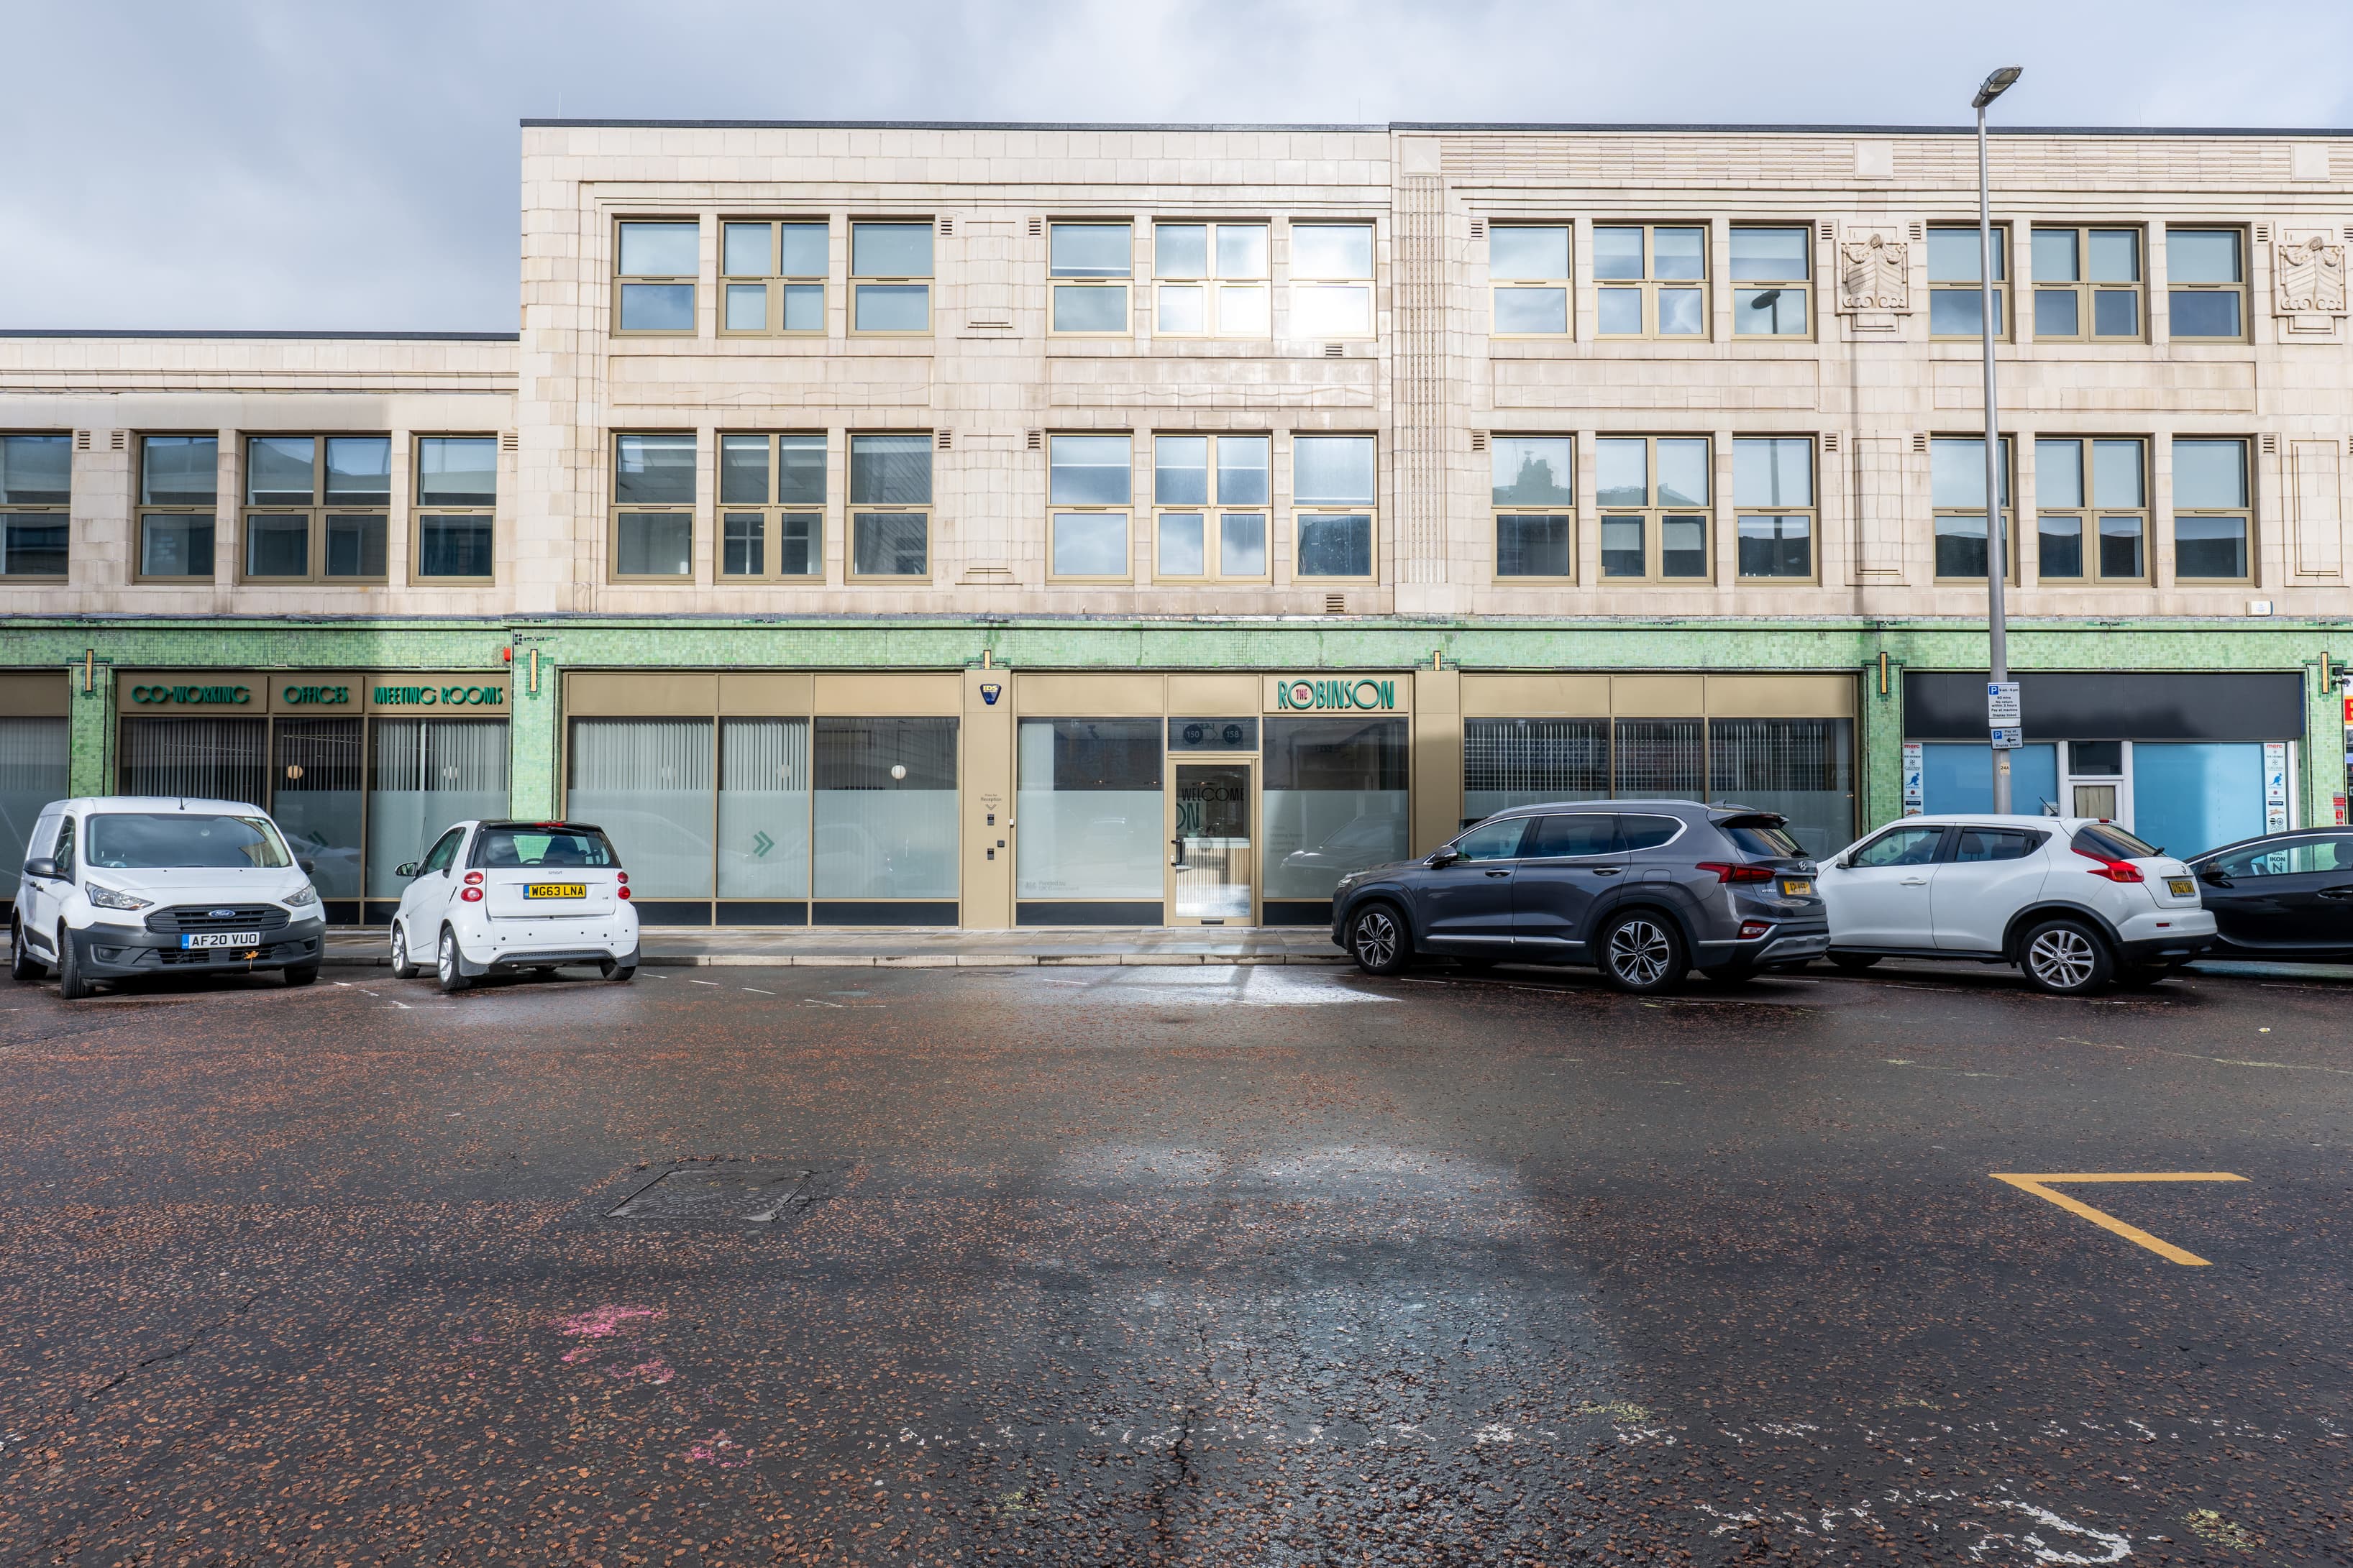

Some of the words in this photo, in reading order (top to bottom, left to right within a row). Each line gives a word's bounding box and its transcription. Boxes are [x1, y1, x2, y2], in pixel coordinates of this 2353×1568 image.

[131, 685, 250, 704] CO-WORKING
[283, 686, 349, 705] OFFICES
[373, 687, 437, 705] MEETING
[440, 686, 503, 705] ROOMS
[1278, 679, 1394, 710] ROBINSON
[1296, 689, 1307, 700] THE
[1182, 787, 1245, 802] WELCOME
[531, 886, 560, 896] WG63
[563, 886, 584, 896] LNA
[191, 935, 227, 946] AF20
[232, 933, 257, 944] VUO
